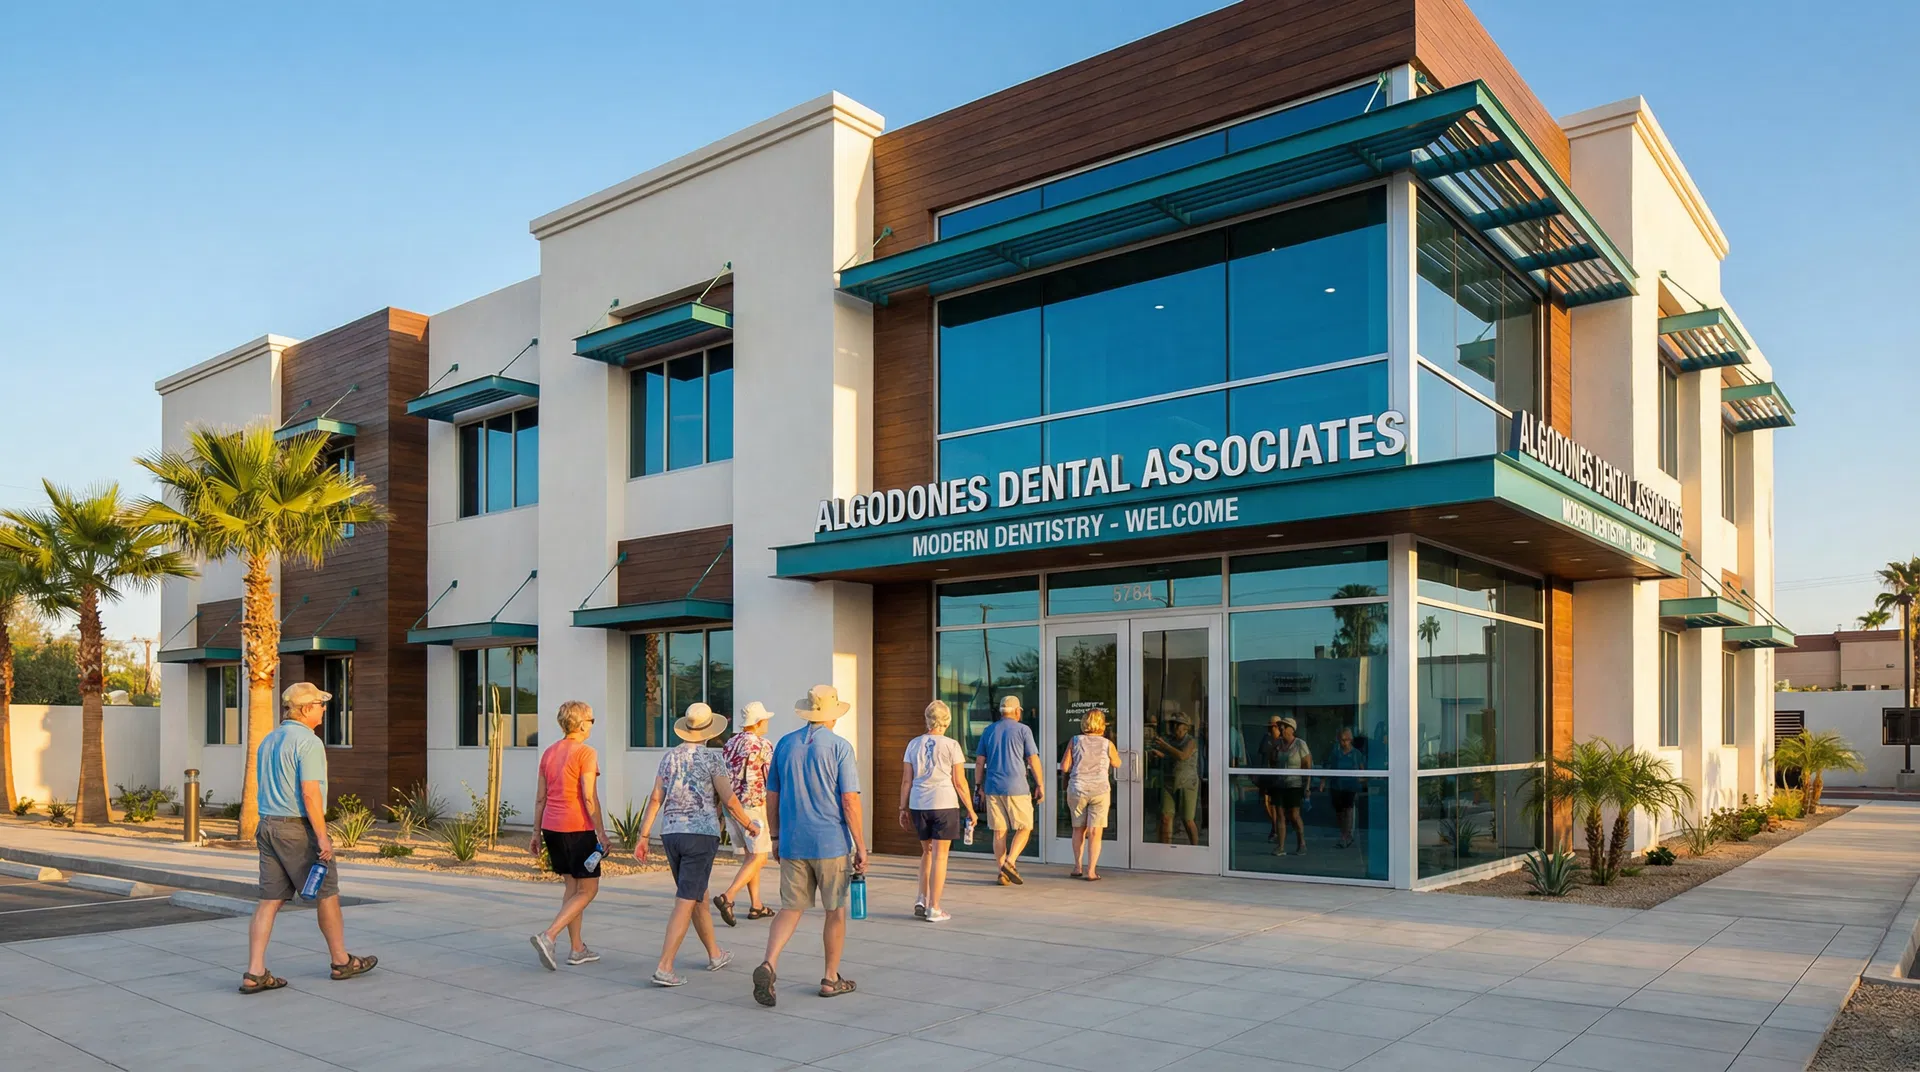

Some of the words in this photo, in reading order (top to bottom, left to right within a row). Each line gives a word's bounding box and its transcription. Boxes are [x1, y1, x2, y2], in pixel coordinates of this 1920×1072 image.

[814, 475, 988, 533] ALGODONES
[998, 454, 1131, 508] DENTAL
[1141, 410, 1406, 488] ASSOCIATES
[912, 528, 989, 557] MODERN
[995, 514, 1104, 548] DENTISTRY
[1109, 521, 1119, 530] -
[1125, 497, 1239, 533] WELCOME
[1519, 409, 1594, 490] ALGODONES
[1595, 454, 1634, 512] DENTAL
[1634, 480, 1683, 538] ASSOCIATES
